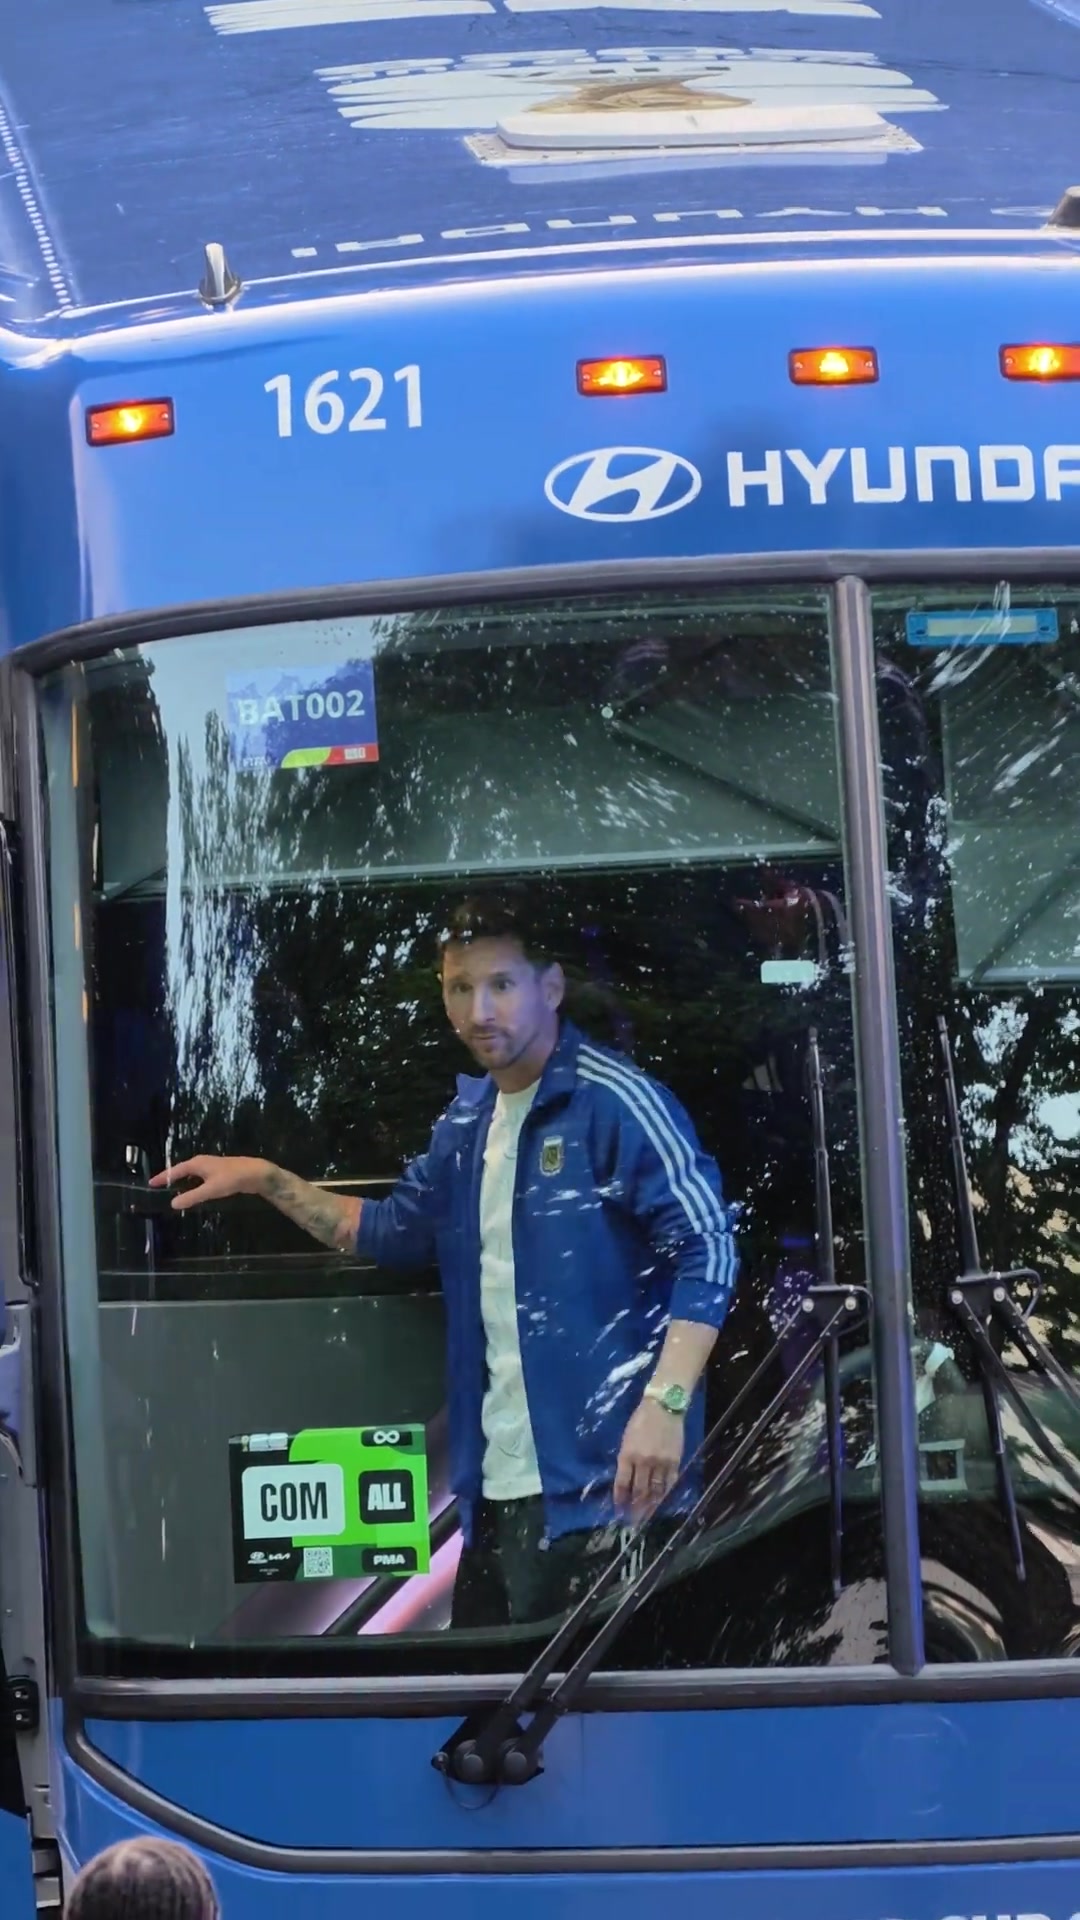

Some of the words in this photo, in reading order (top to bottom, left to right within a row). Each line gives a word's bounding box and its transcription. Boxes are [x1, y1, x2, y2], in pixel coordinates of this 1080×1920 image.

[264, 364, 422, 437] 1621
[237, 690, 365, 726] BAT002
[260, 1481, 328, 1522] COM
[367, 1482, 406, 1511] ALL
[373, 1554, 406, 1566] PMA
